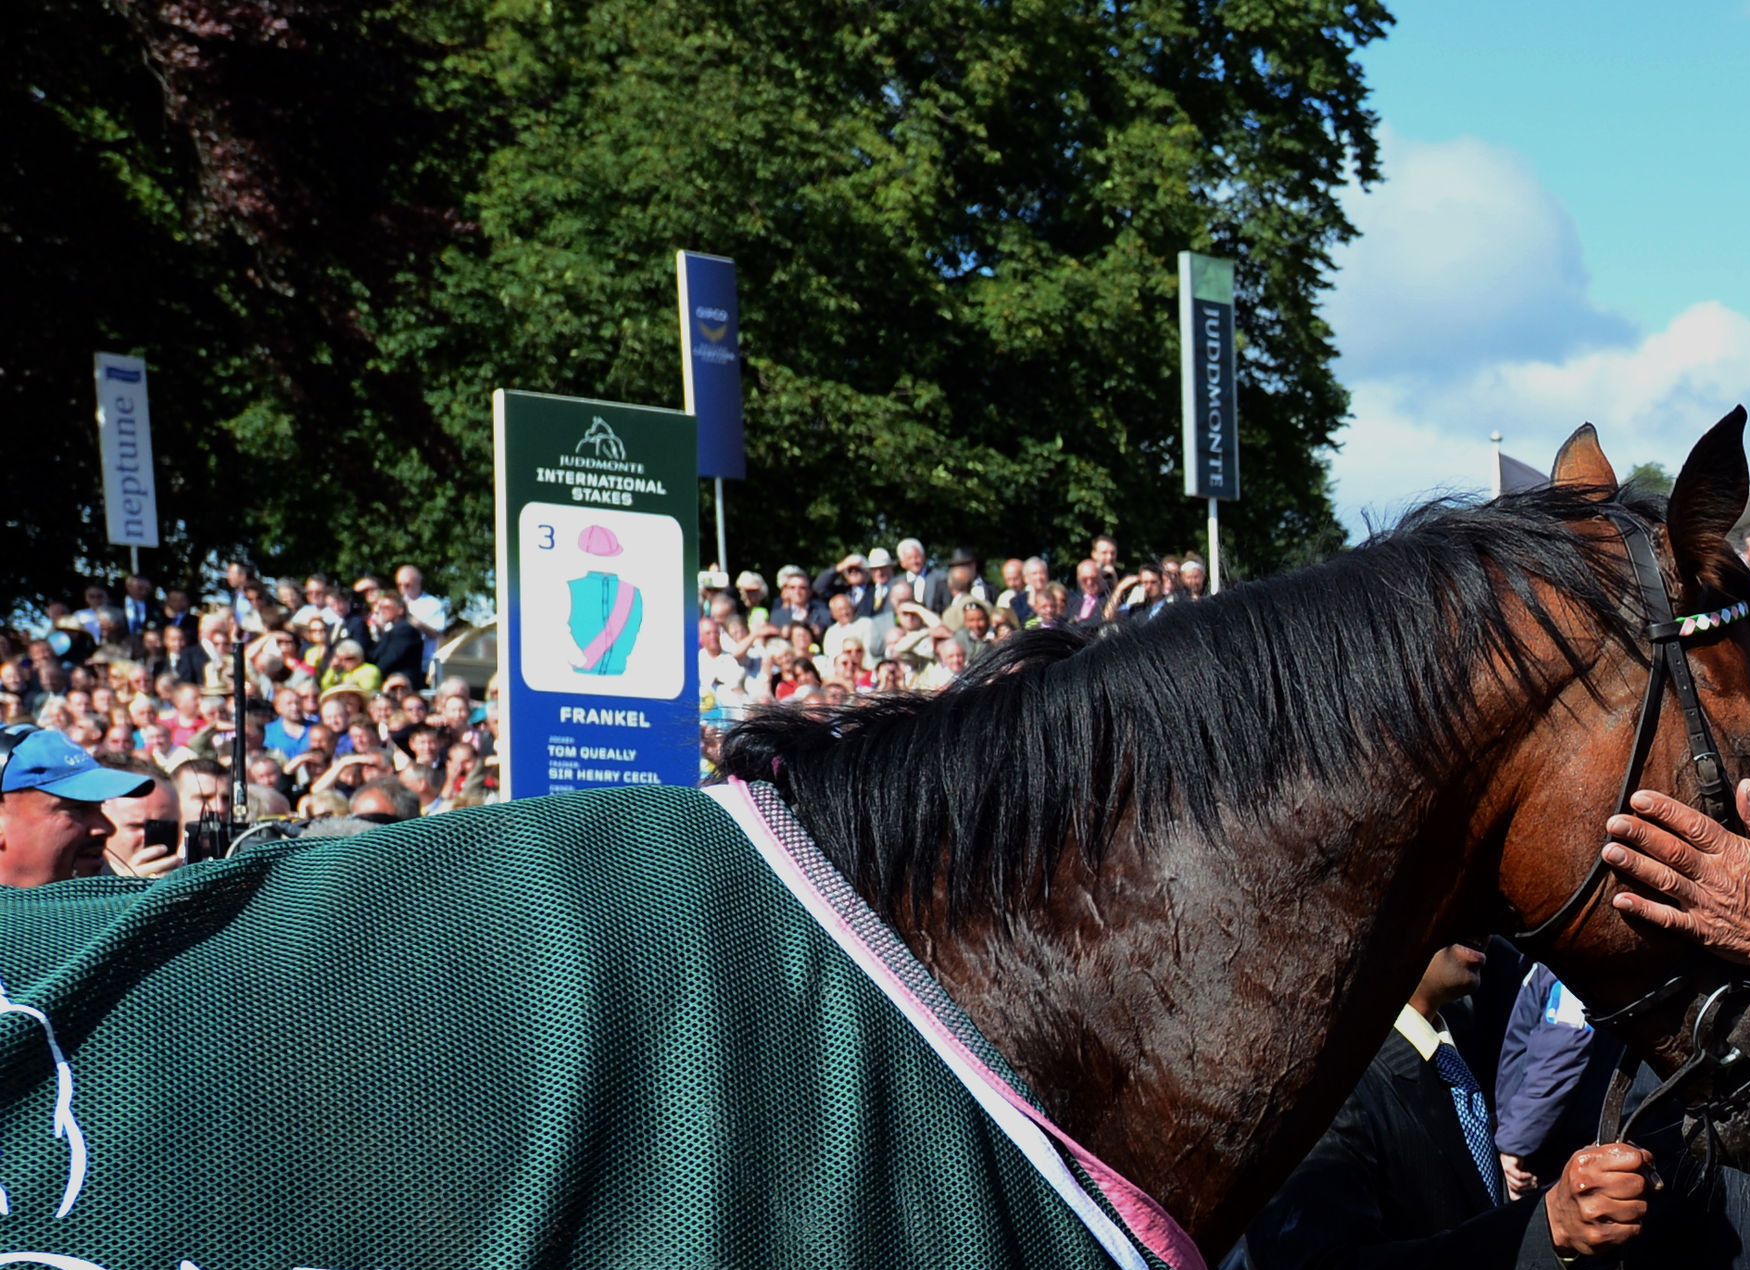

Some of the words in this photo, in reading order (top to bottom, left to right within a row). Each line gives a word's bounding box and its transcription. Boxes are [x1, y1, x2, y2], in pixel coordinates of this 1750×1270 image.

[1202, 306, 1224, 488] JUDDMONTE
[115, 396, 148, 538] neptune
[559, 454, 645, 475] JUDDMONTE
[536, 466, 667, 496] INTERNATIONAL
[571, 486, 633, 506] STAKES
[536, 524, 555, 551] 3
[560, 706, 651, 728] FRANKEL
[547, 744, 577, 758] TOM
[580, 746, 637, 761] QUEALLY
[548, 767, 574, 780] SIR
[576, 769, 621, 783] HENRY
[623, 771, 662, 785] CECIL
